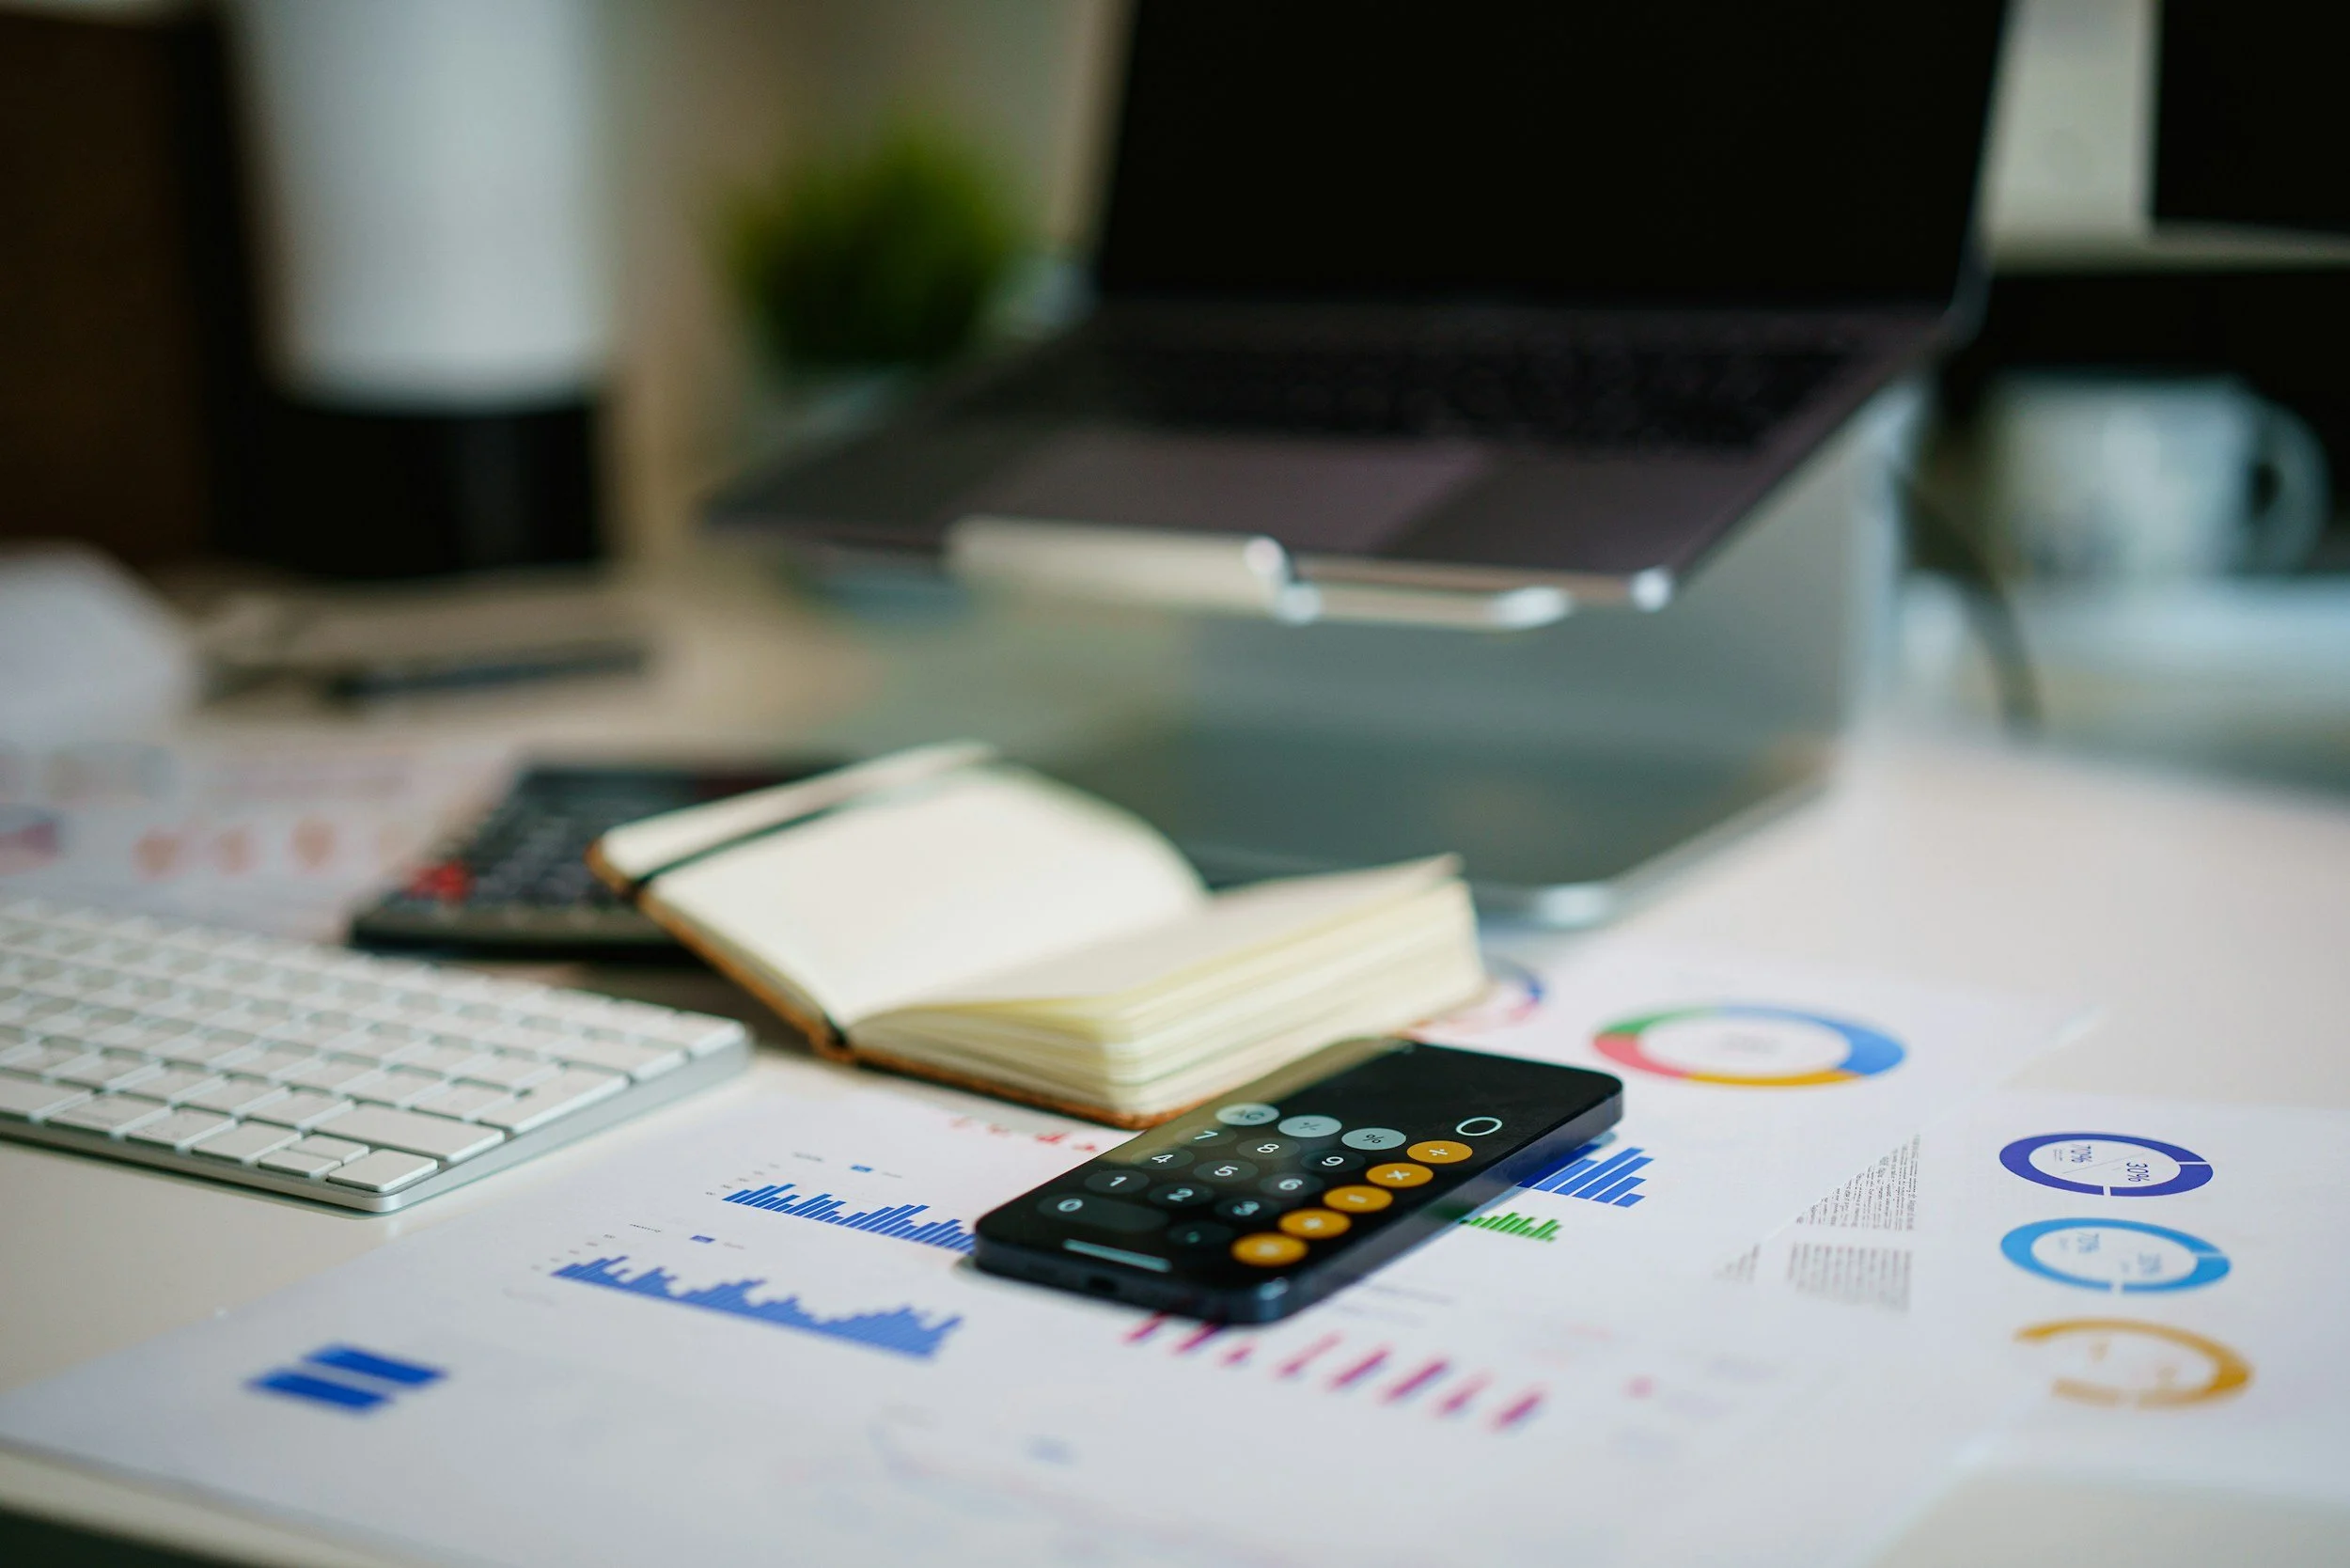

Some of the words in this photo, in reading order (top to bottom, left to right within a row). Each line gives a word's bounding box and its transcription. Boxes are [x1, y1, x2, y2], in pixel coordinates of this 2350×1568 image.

[1456, 1117, 1503, 1137] 0
[1194, 1130, 1219, 1140] 7
[1257, 1143, 1280, 1153] 8
[1152, 1153, 1174, 1164] 4
[1321, 1156, 1344, 1167] 9
[1214, 1166, 1239, 1177] 5
[2125, 1162, 2151, 1183] 30%
[1109, 1176, 1127, 1187] 1
[1277, 1178, 1304, 1191] 6
[1167, 1187, 1194, 1202] 2
[1058, 1198, 1084, 1213] 0
